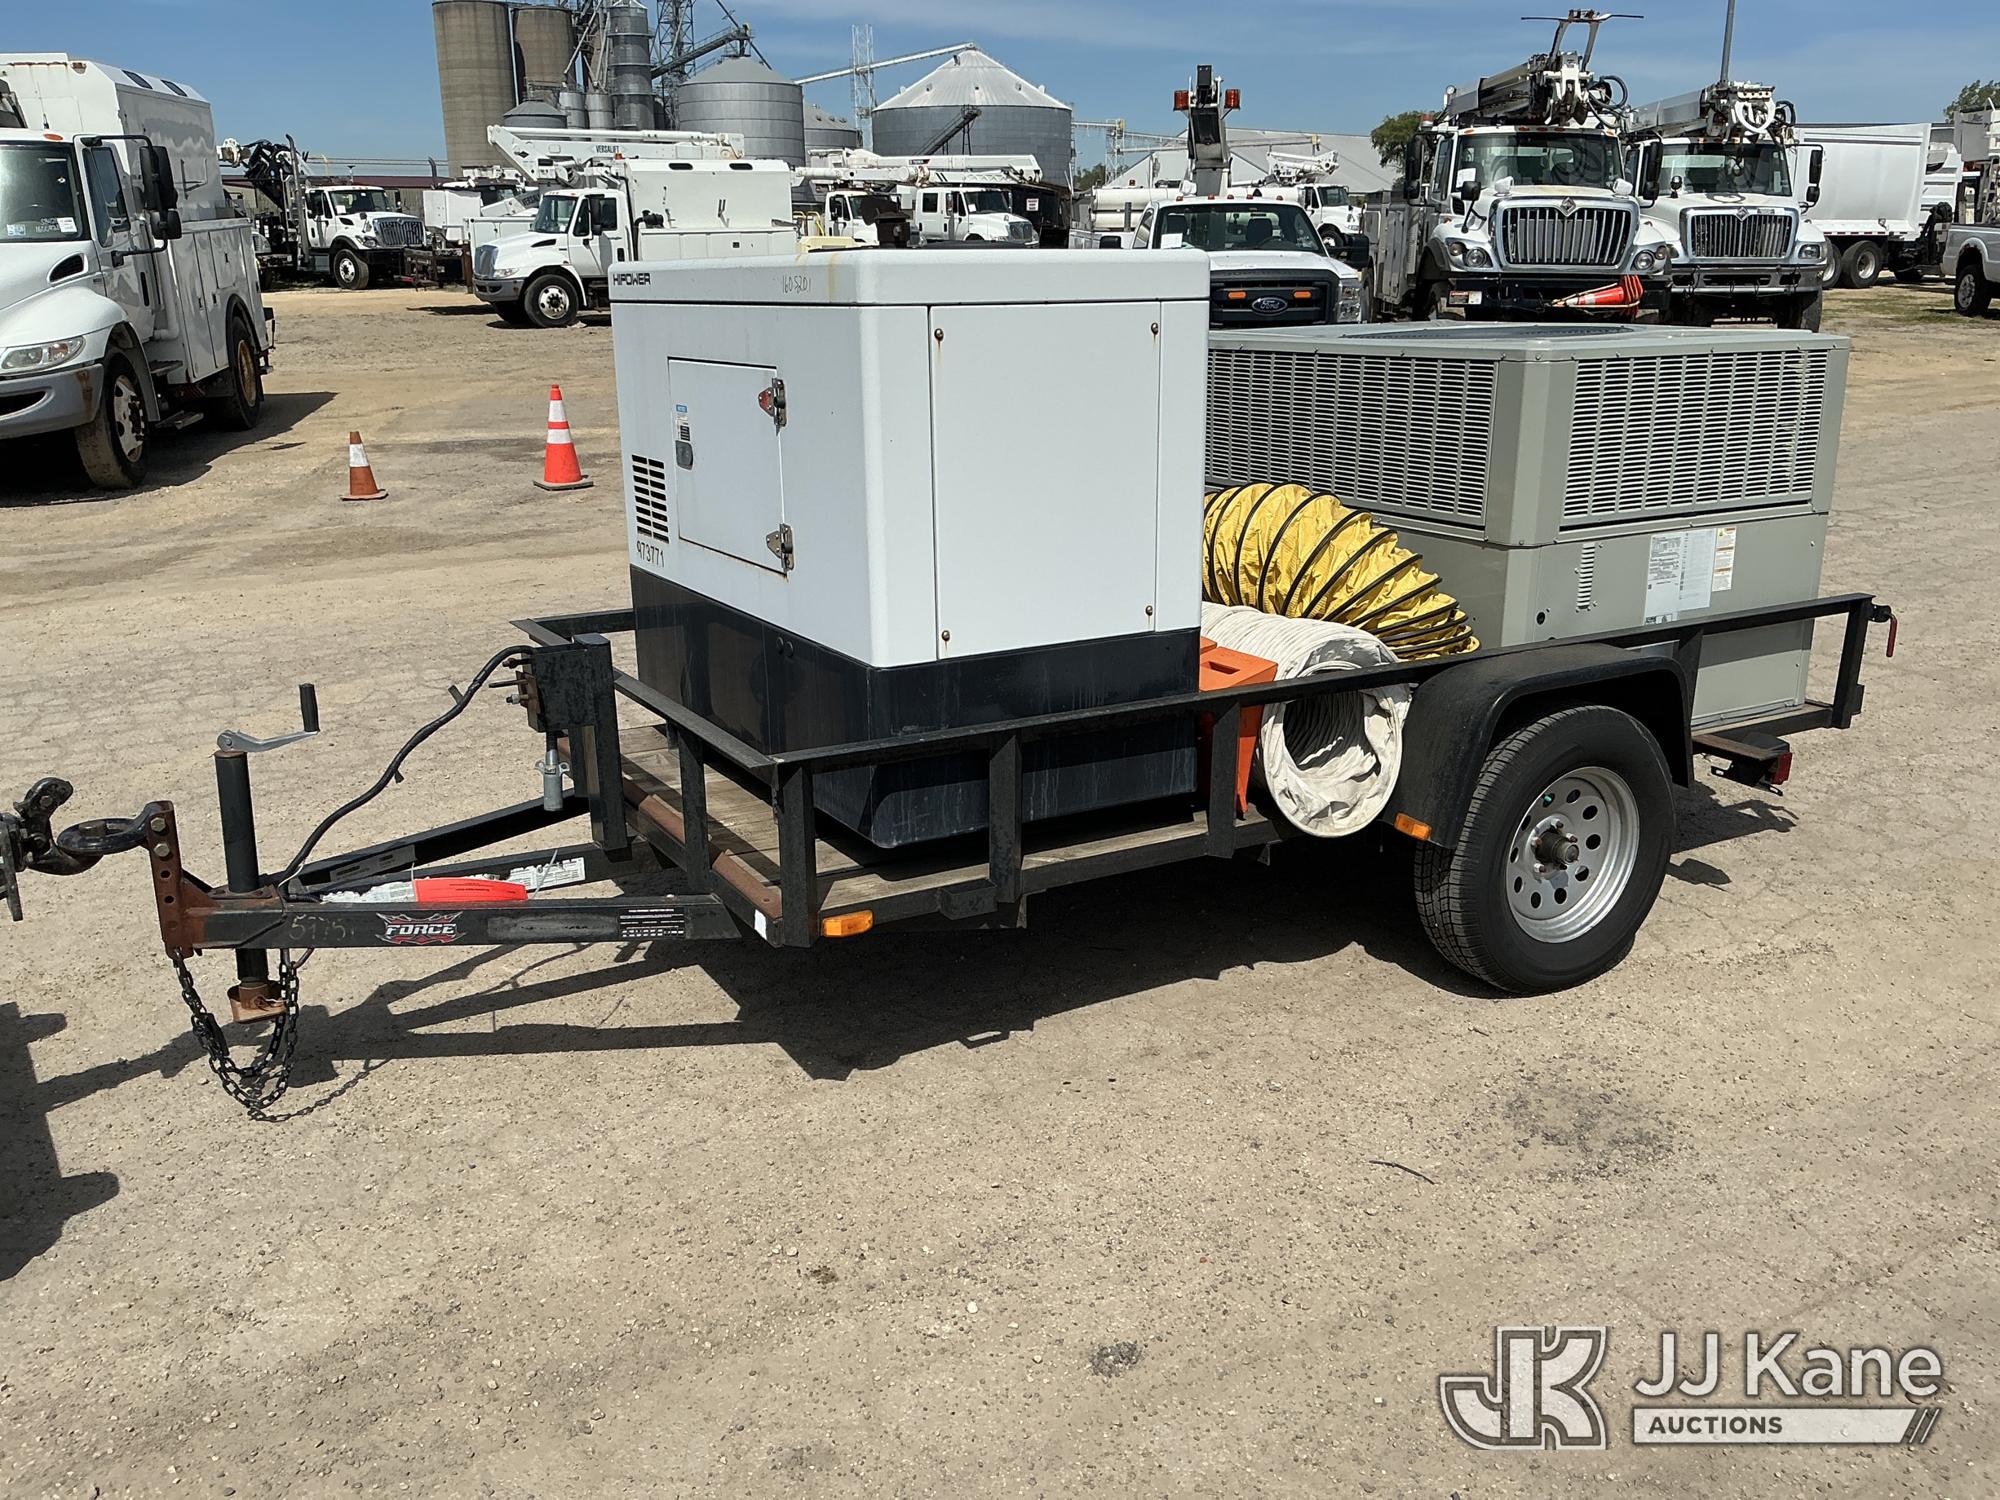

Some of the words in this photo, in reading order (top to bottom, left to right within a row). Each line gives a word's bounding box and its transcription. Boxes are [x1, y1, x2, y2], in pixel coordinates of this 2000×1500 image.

[595, 145, 620, 153] VERSALIFT
[612, 273, 651, 286] HIPOWER
[1260, 300, 1280, 310] Ford
[636, 540, 665, 568] 973771
[386, 923, 457, 935] FORCE
